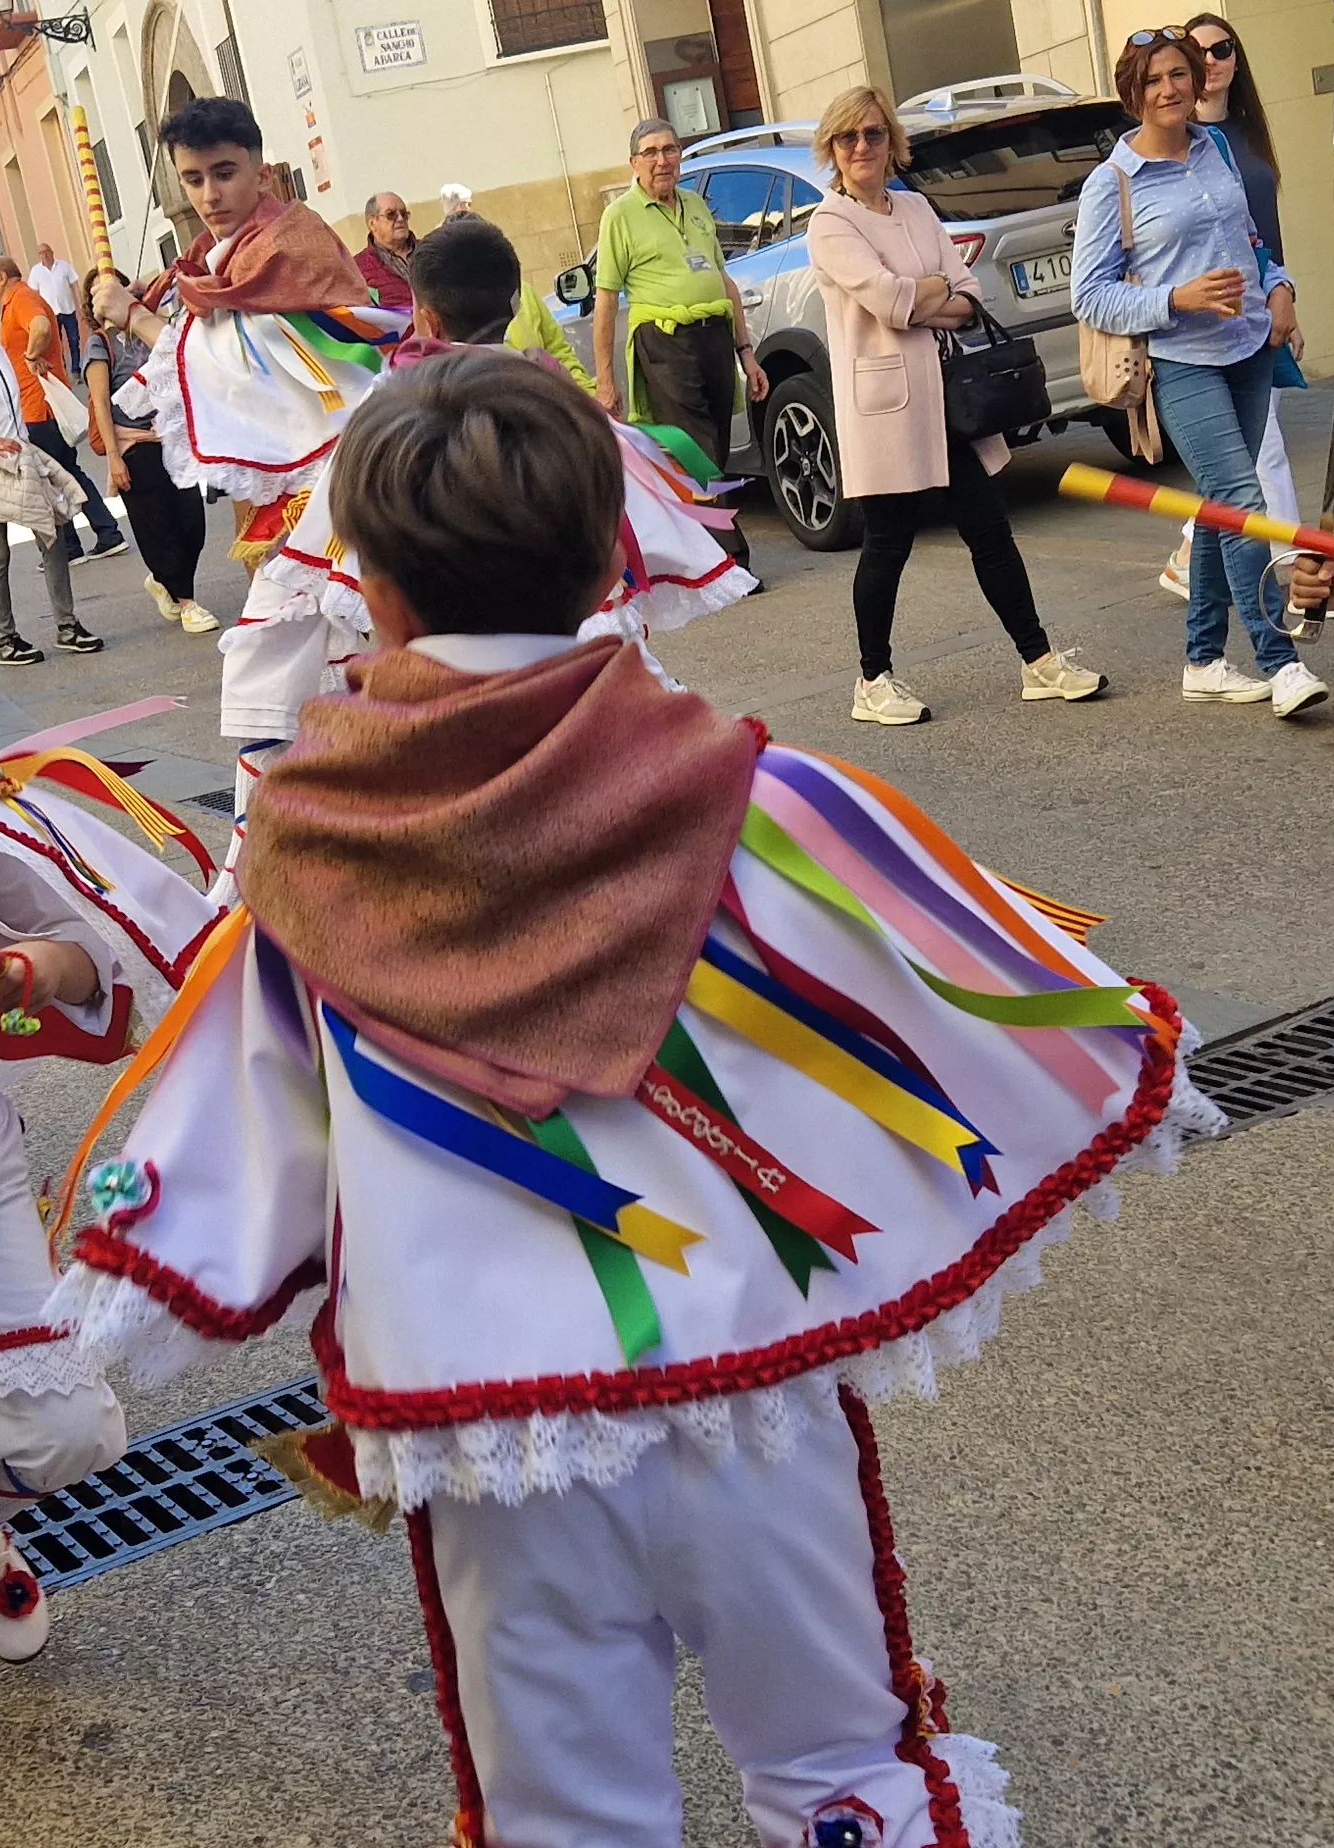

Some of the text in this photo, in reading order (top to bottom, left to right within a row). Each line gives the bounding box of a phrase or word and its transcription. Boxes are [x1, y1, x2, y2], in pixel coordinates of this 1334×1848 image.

[376, 27, 407, 41] CALLE
[380, 38, 415, 53] SANCHO
[374, 50, 412, 67] ABARCA
